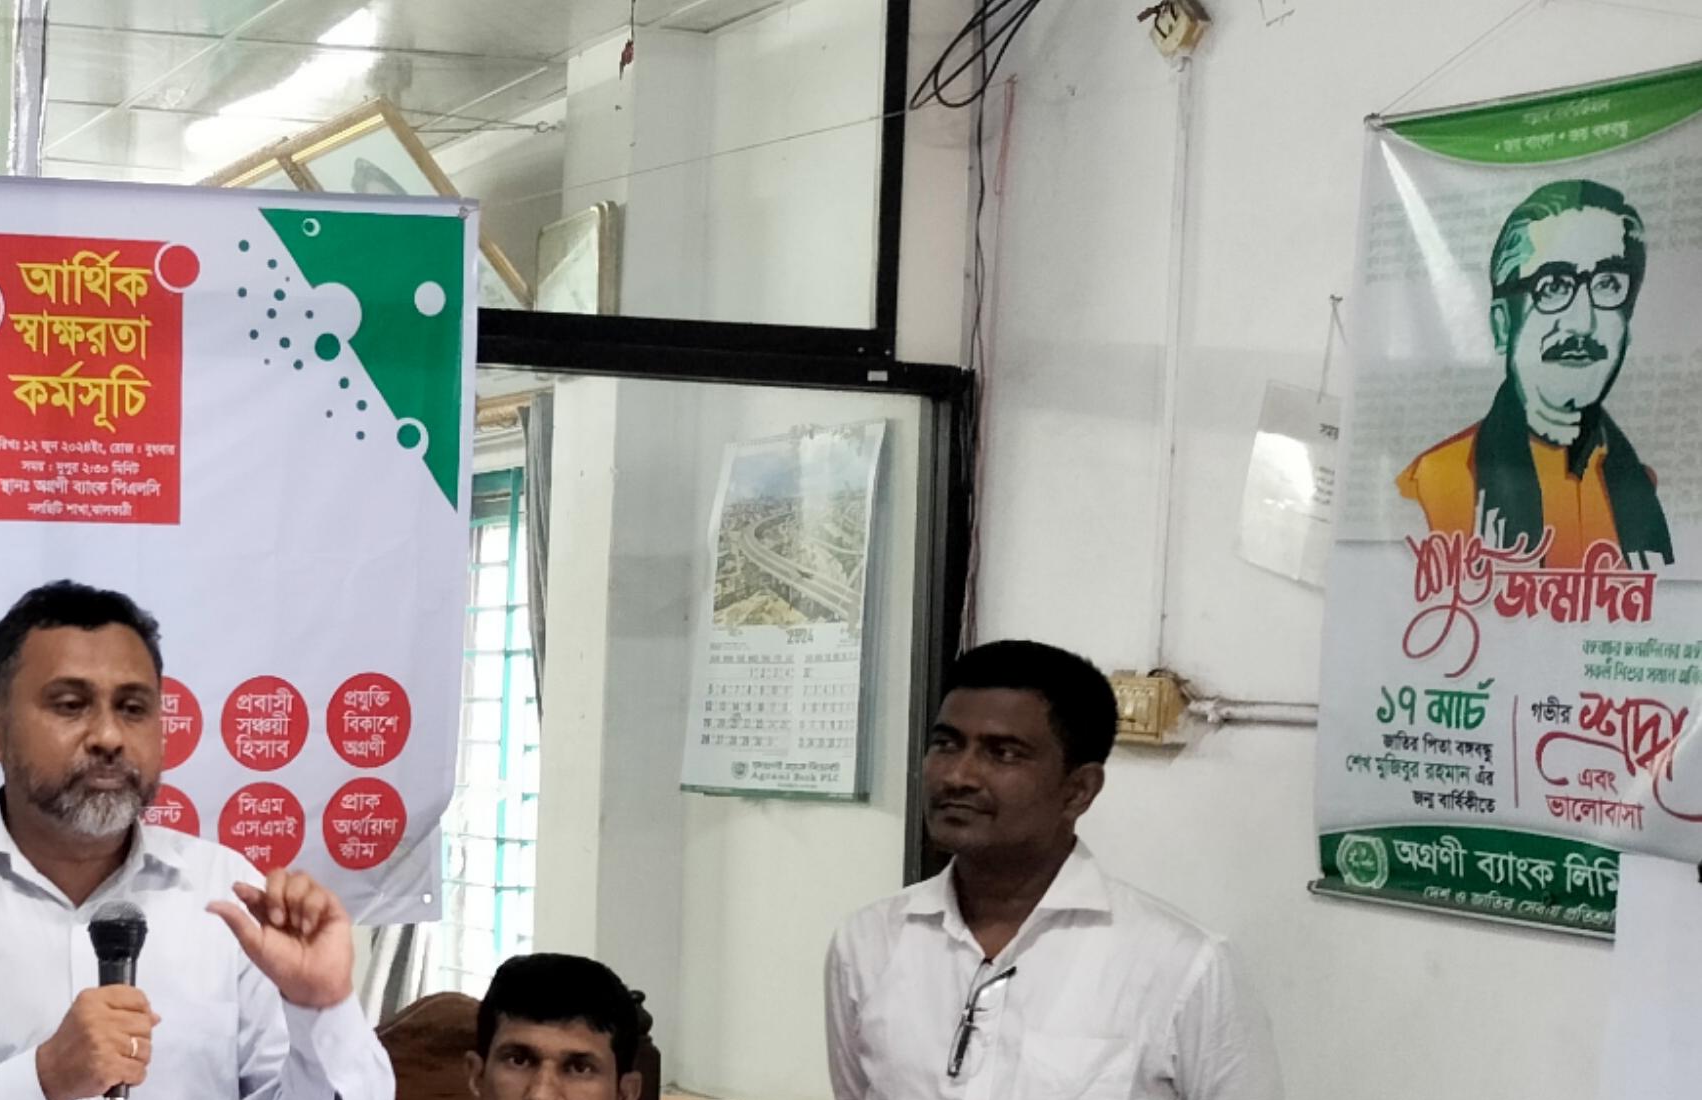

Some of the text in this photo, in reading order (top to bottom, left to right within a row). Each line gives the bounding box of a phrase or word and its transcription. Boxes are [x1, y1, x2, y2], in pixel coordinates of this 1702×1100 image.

[16, 250, 153, 308] আর্থিক
[8, 309, 153, 360] স্বাক্ষরতা
[8, 360, 152, 433] কর্মসূচি
[1494, 542, 1657, 623] জন্মদিন
[236, 687, 294, 713] প্রবাসী
[343, 685, 391, 710] প্রযুক্তি
[1377, 678, 1495, 730] ১৭ মার্চ
[1531, 695, 1573, 724] গভীর
[343, 712, 398, 733] বিকাশে
[235, 736, 290, 759] হিসাব
[342, 736, 386, 757] অগ্রণী
[1382, 730, 1419, 751] জাতির
[1422, 733, 1452, 755] পিতা
[1346, 754, 1372, 773] শেখ
[1375, 752, 1420, 782] মুজিবুর
[1425, 763, 1471, 784] রহমান
[1579, 769, 1618, 795] এবং
[238, 793, 285, 815] সিএম
[340, 793, 381, 810] প্রাক
[1545, 795, 1644, 830] ভালোবাসা
[231, 816, 298, 838] এসএমই
[1393, 835, 1468, 879] অগ্রণী
[1474, 850, 1556, 891] ব্যাংক
